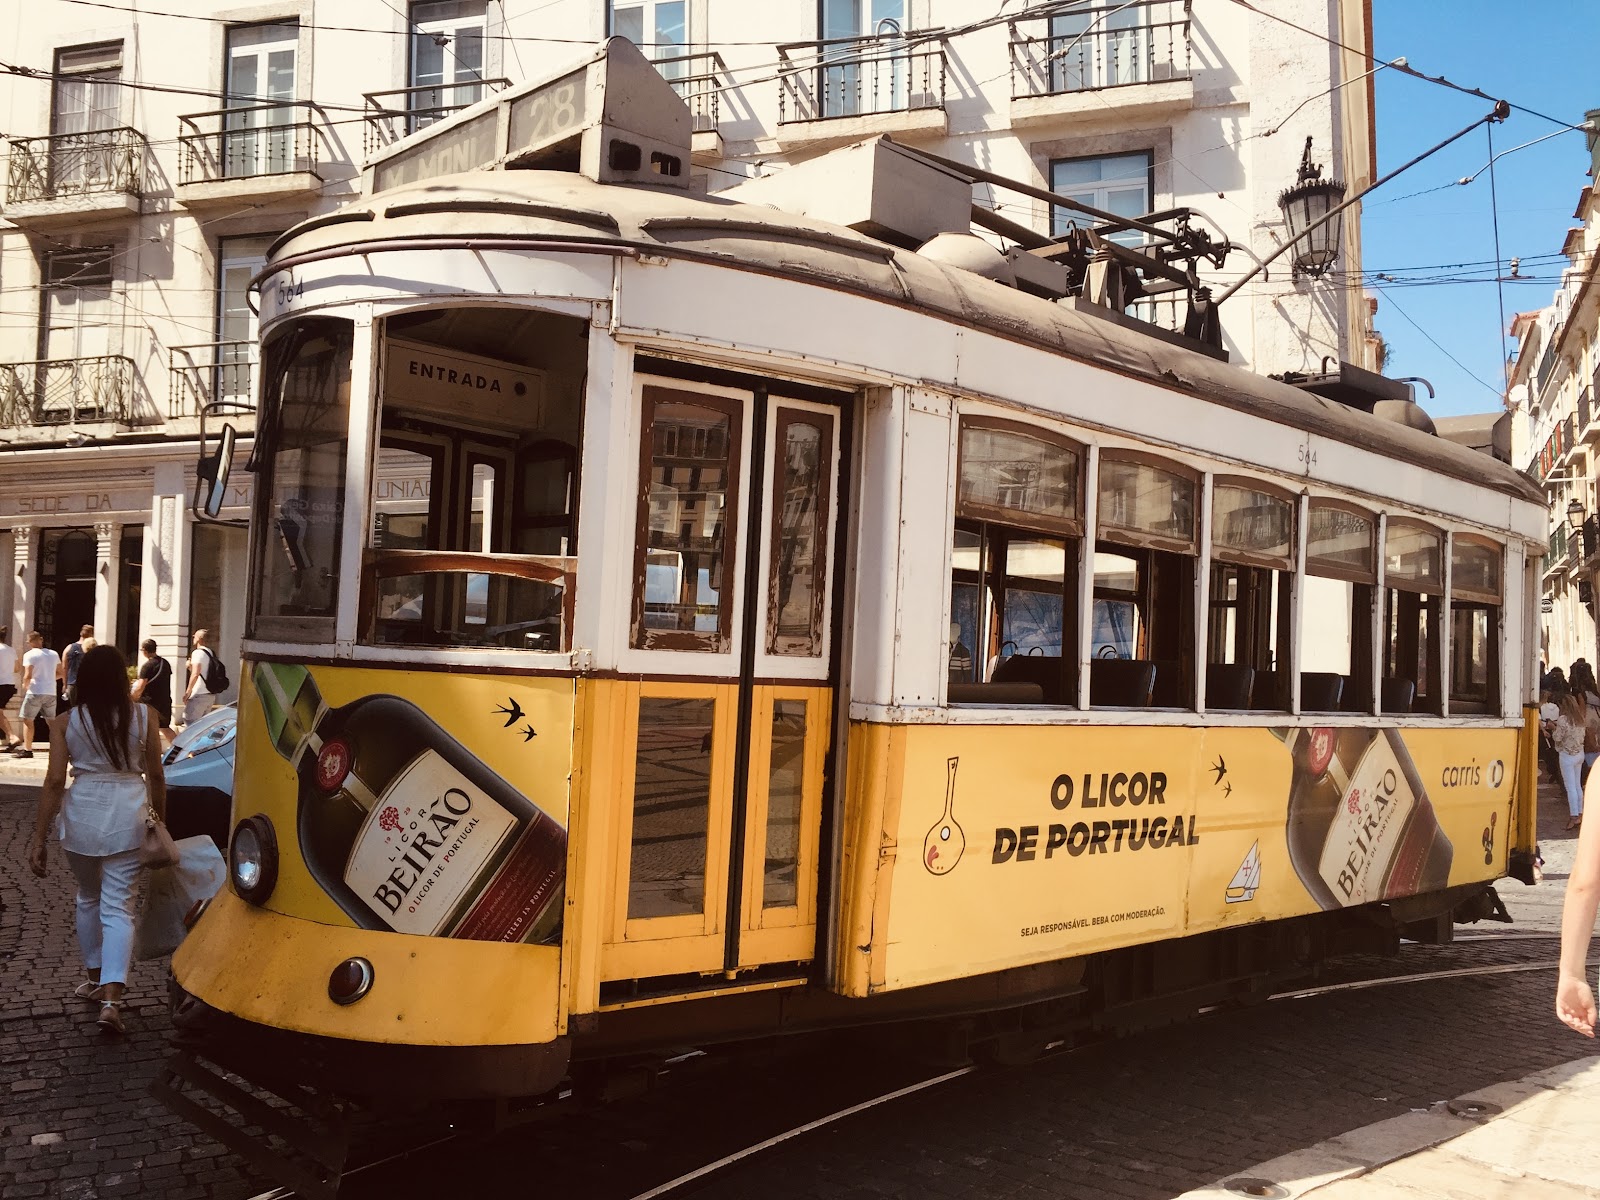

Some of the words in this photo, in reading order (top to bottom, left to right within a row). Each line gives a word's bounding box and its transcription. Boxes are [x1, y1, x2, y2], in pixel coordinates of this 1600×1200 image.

[529, 82, 576, 145] 28
[278, 276, 304, 305] 564
[409, 360, 502, 393] ENTRADA
[1297, 444, 1317, 466] 564
[19, 495, 70, 512] SEDE
[86, 493, 112, 510] DA
[1050, 773, 1074, 811] O
[1081, 771, 1167, 809] LICOR
[1441, 757, 1481, 788] carris
[388, 808, 427, 863] LICOR
[991, 825, 1039, 865] DE
[1044, 814, 1200, 859] PORTUGAL
[1336, 768, 1397, 899] BEIRÃO
[1376, 798, 1399, 843] PORTUGAL
[373, 787, 472, 916] BEIRÃO
[408, 905, 416, 914] O
[413, 878, 435, 906] LICOR
[432, 863, 445, 878] DE
[443, 817, 480, 863] PORTUGAL
[530, 870, 557, 905] PORTUGAL
[1020, 926, 1039, 937] SEJA
[1040, 917, 1091, 935] RESPONSÁVEL.
[1091, 915, 1110, 926] BEBA
[1110, 912, 1125, 923] COM
[1125, 905, 1166, 921] MODERAÇÃO.
